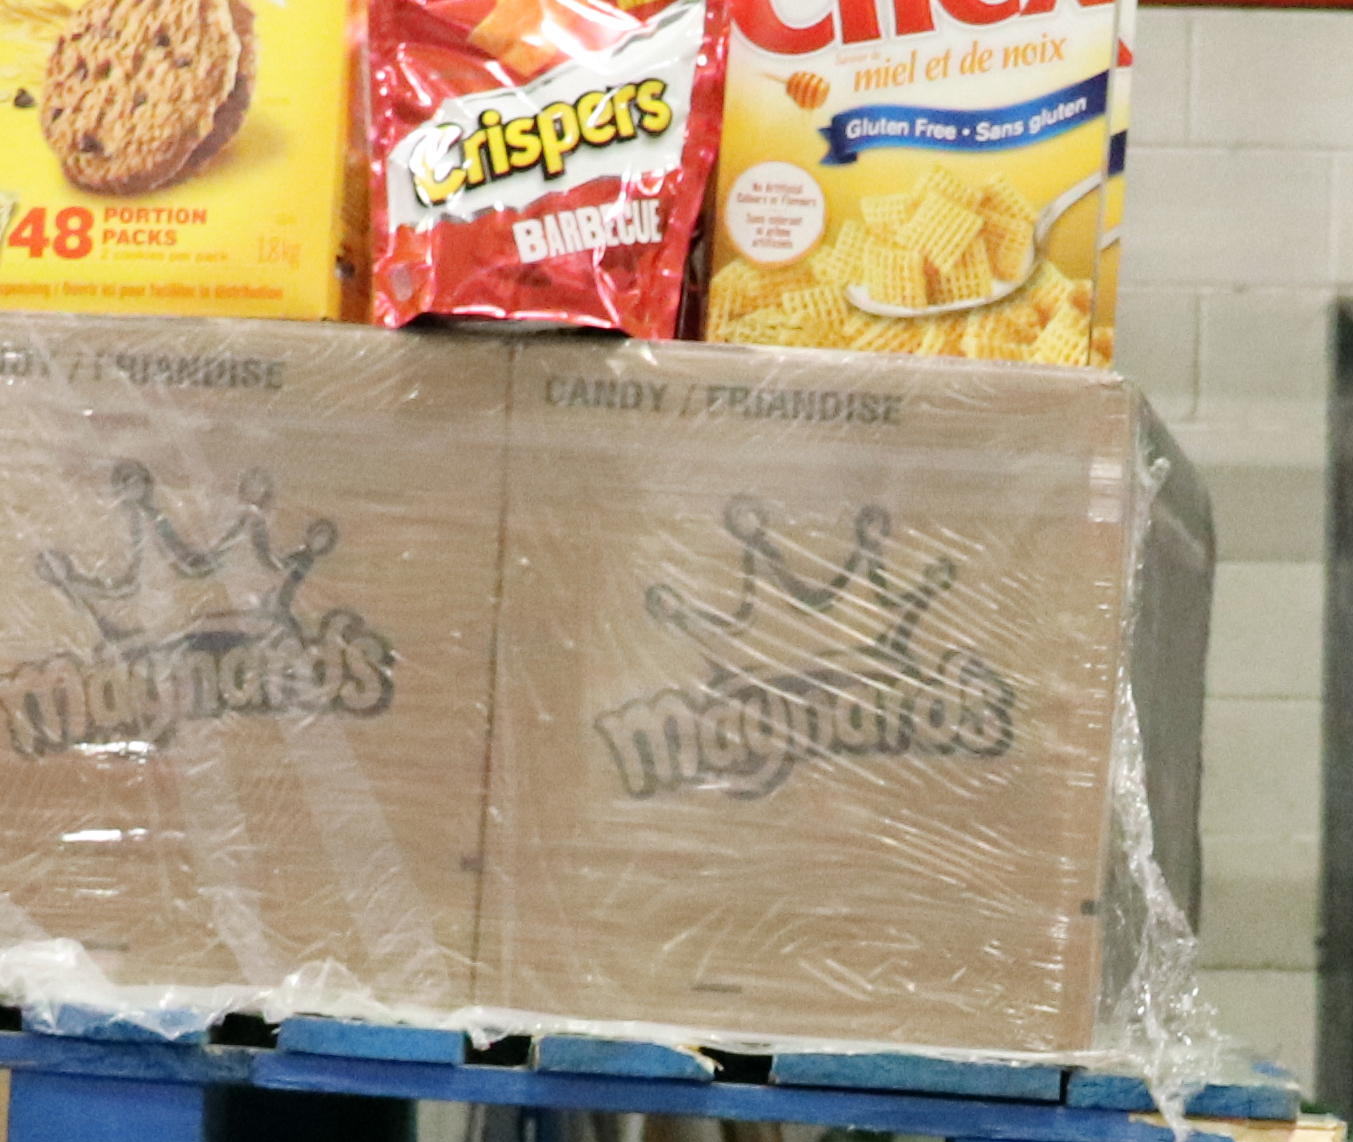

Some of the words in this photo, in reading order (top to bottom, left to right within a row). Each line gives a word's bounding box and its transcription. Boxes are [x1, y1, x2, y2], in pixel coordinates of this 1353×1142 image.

[853, 51, 918, 93] miel
[925, 53, 951, 81] et
[959, 42, 994, 75] de
[1002, 32, 1068, 68] noix
[409, 77, 672, 207] Crispers
[845, 118, 910, 139] Gluten
[914, 119, 957, 140] Free
[975, 116, 1024, 143] Sans
[1029, 95, 1088, 134] gluten
[7, 205, 95, 261] 48
[102, 228, 178, 246] PACKS
[103, 206, 208, 226] PORTION
[512, 199, 663, 264] BARBECUE
